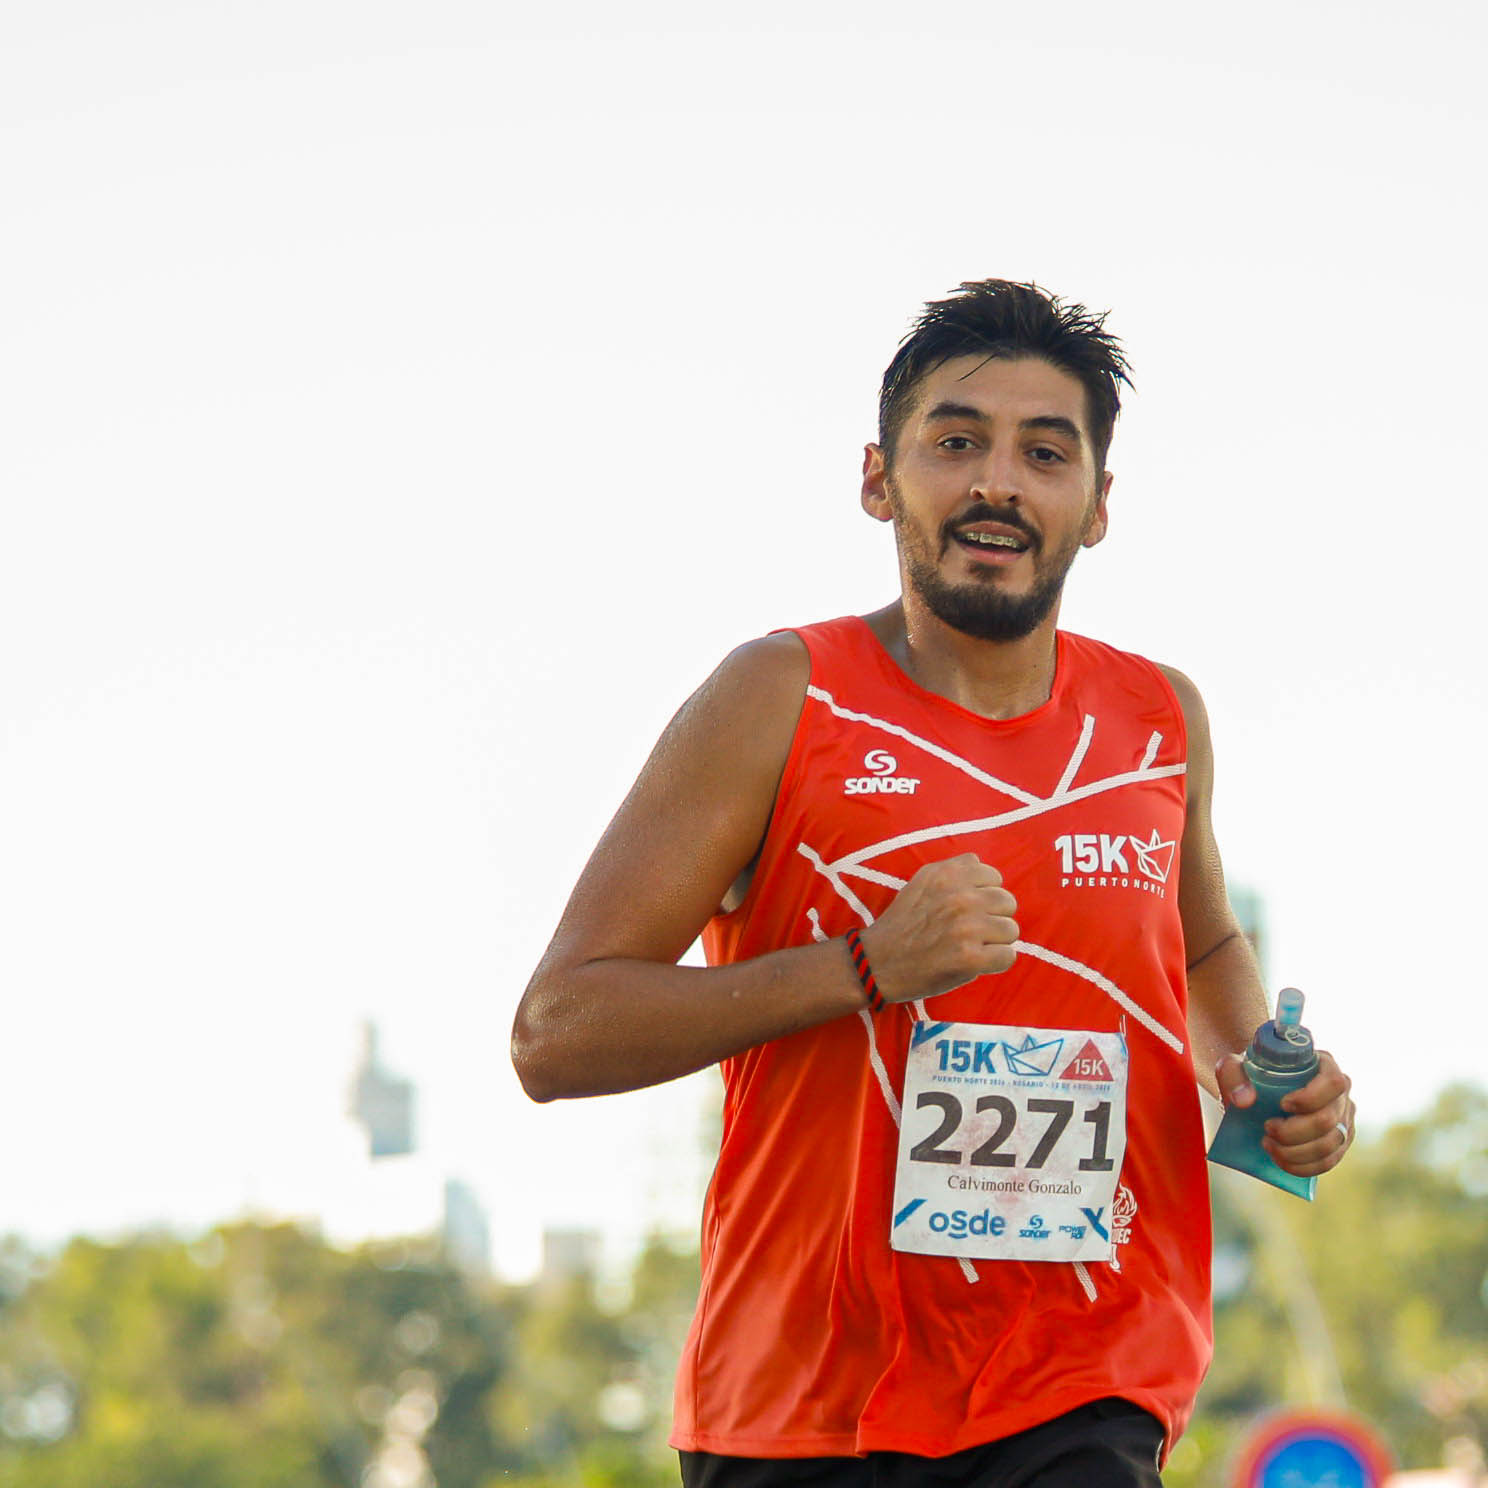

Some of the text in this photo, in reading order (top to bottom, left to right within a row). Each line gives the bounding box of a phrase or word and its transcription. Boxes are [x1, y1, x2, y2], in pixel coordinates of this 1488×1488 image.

[1055, 833, 1129, 873] 15K
[1062, 877, 1164, 898] PUERTO NORTE
[935, 1039, 997, 1074] 15K
[1073, 1058, 1104, 1076] 15K
[910, 1091, 1114, 1172] 2271
[947, 1175, 1082, 1195] Calvimonte Gonzalo
[929, 1208, 1005, 1239] osde
